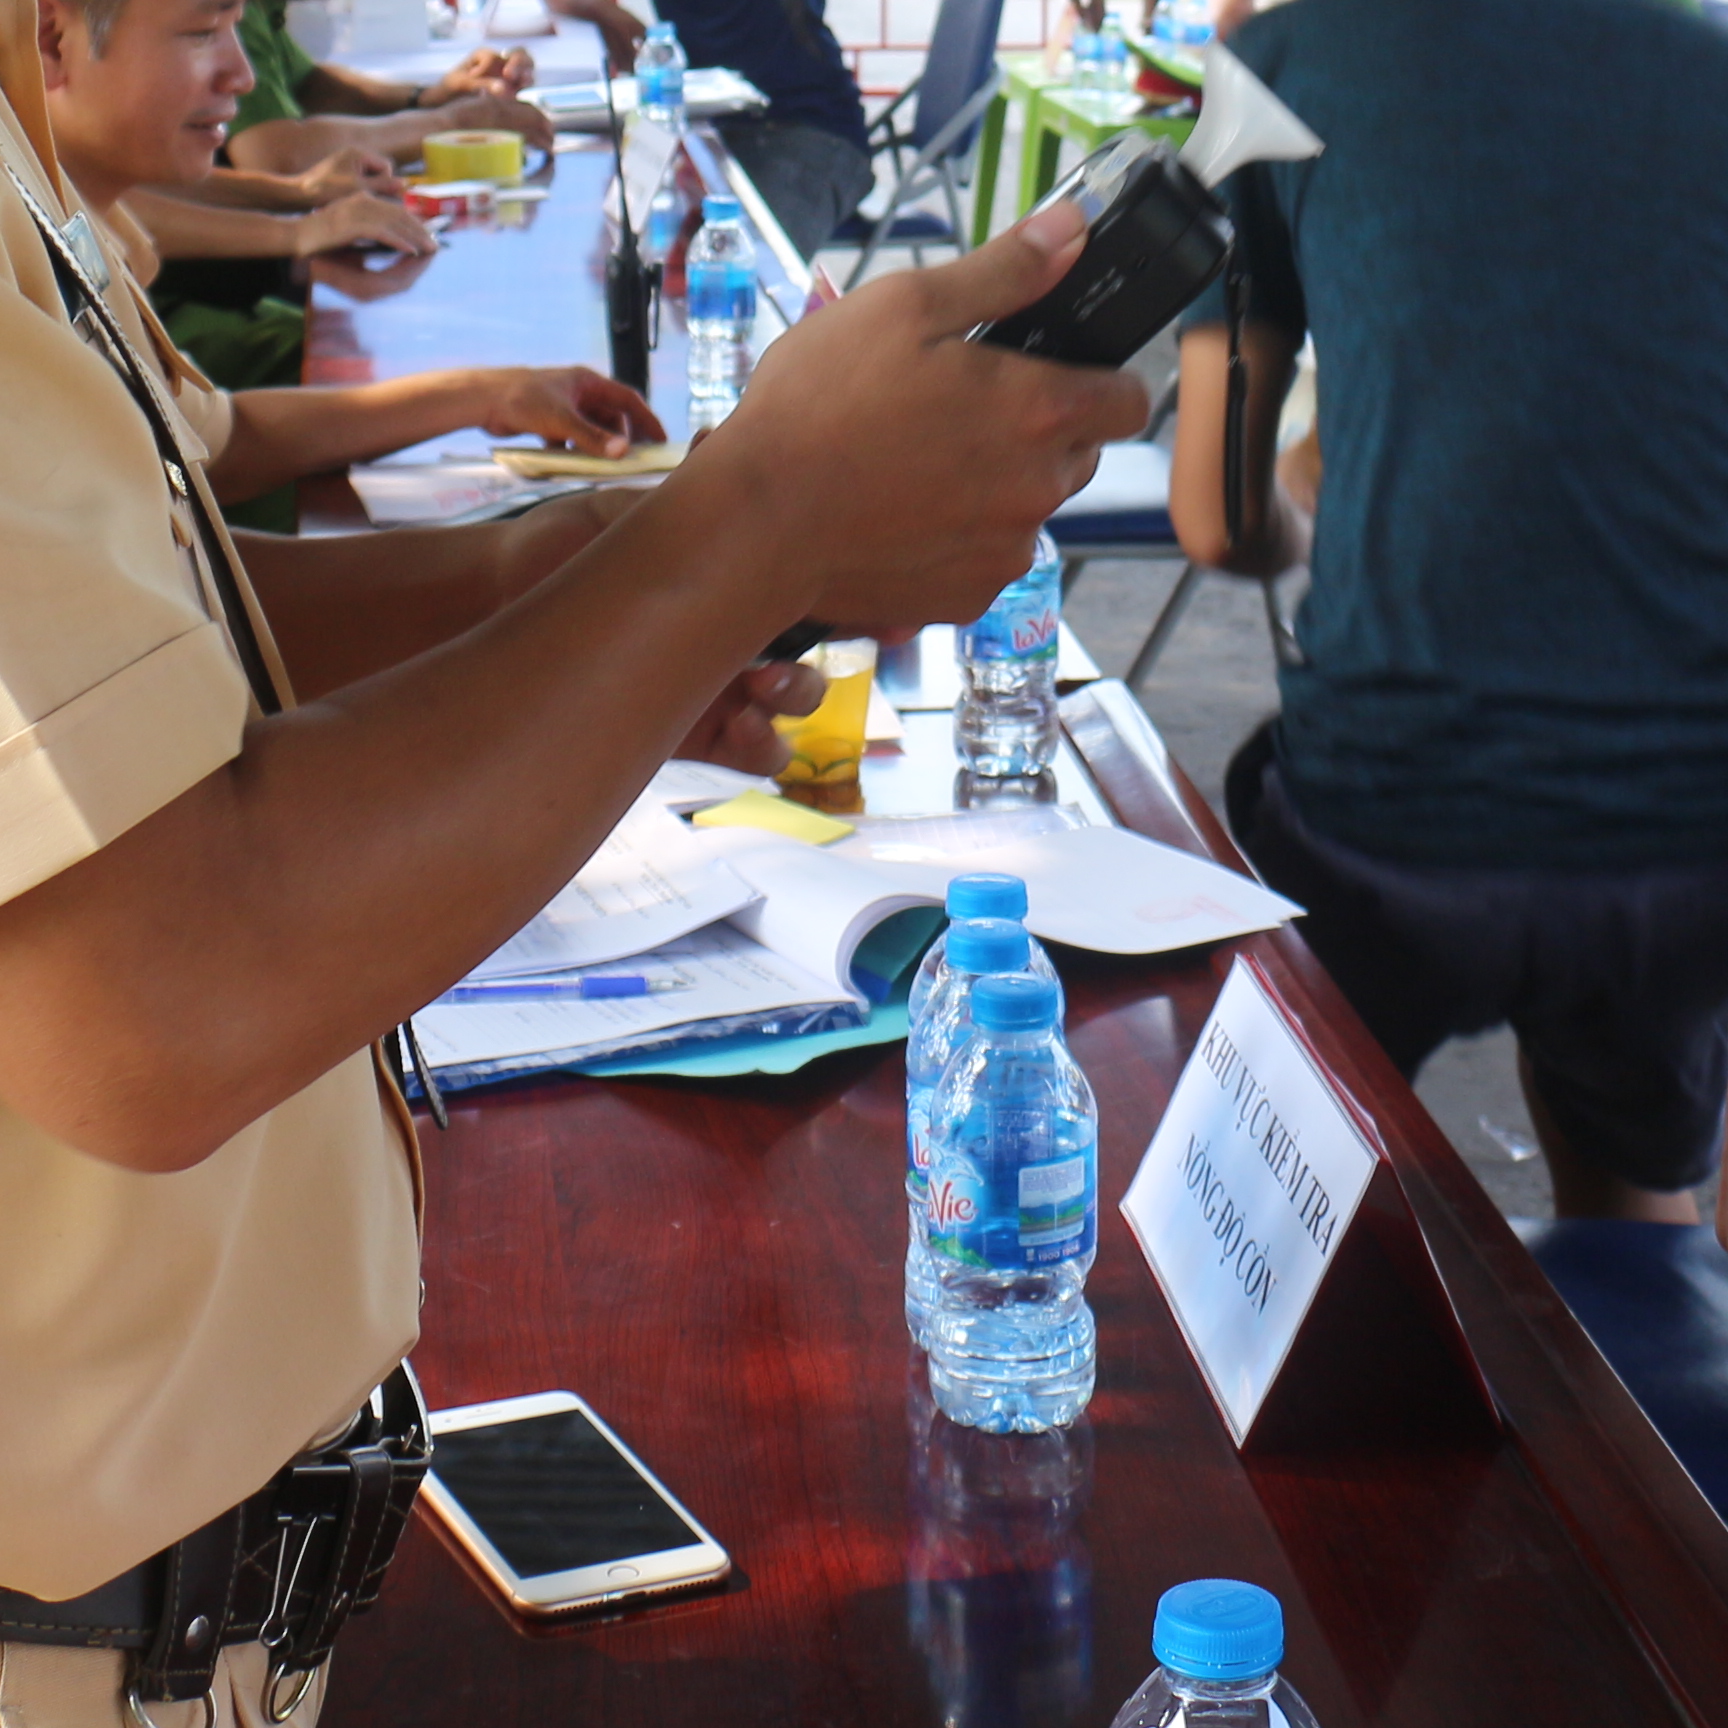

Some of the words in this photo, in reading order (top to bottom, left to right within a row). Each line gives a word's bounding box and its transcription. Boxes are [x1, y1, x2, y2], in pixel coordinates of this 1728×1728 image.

[1177, 1133, 1225, 1222] NỒNG
[1213, 1197, 1246, 1266] ĐỘ
[1235, 1240, 1277, 1317] CỒN
[1201, 1020, 1242, 1091] KHU
[1233, 1065, 1271, 1140] VỰC
[1259, 1113, 1310, 1205] KIỂM
[1298, 1175, 1339, 1258] TRA
